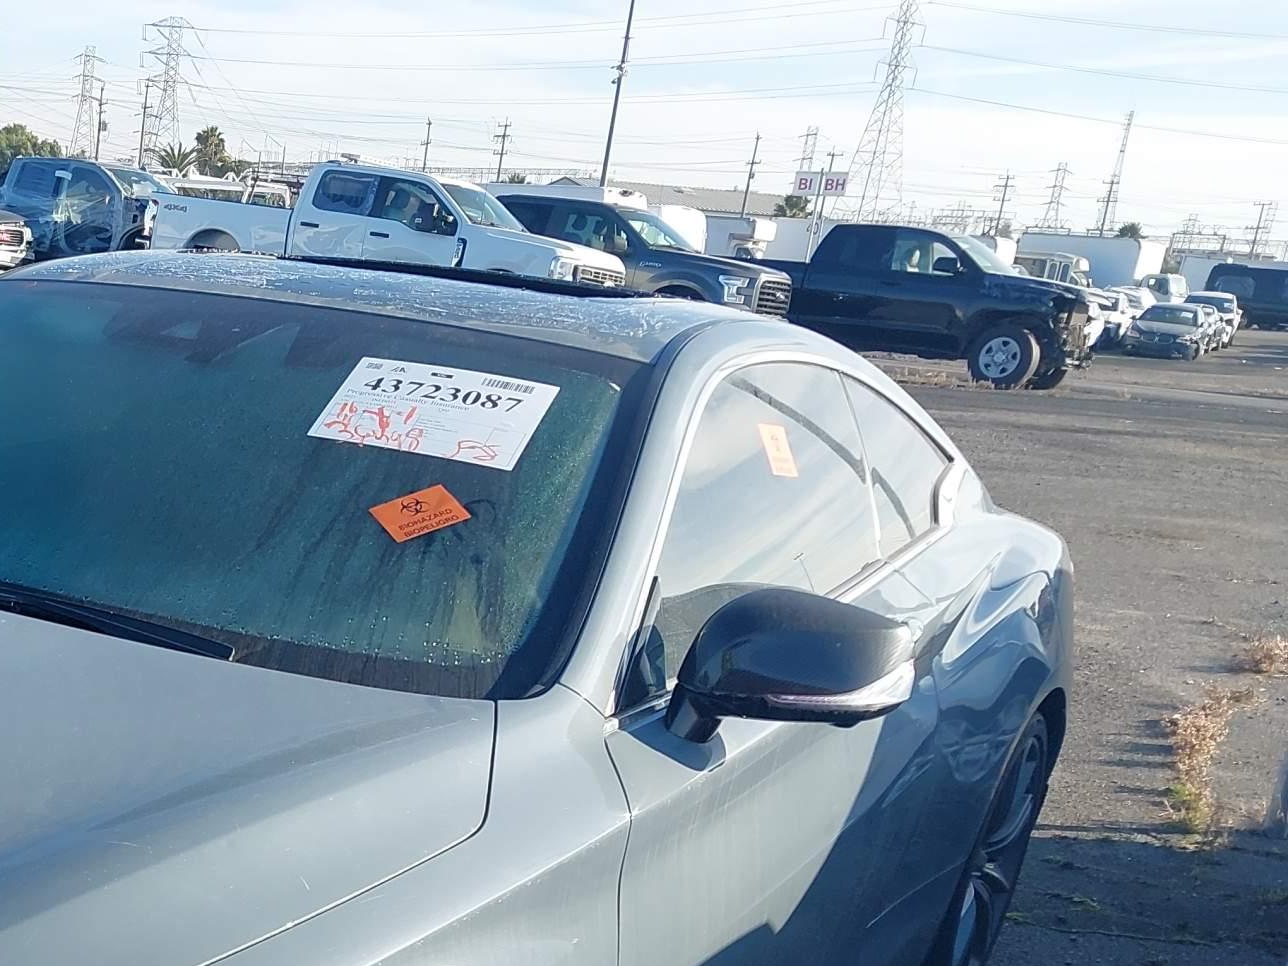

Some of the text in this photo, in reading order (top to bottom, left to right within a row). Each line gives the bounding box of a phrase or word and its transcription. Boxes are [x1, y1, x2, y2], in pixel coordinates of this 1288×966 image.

[797, 177, 814, 191] BI
[823, 178, 847, 191] BH
[345, 388, 391, 399] Progressive
[430, 399, 471, 411] Insurance
[363, 377, 524, 412] 43723087
[398, 508, 453, 531] BIOHAZARD
[403, 514, 459, 538] BIOPELIGRO
